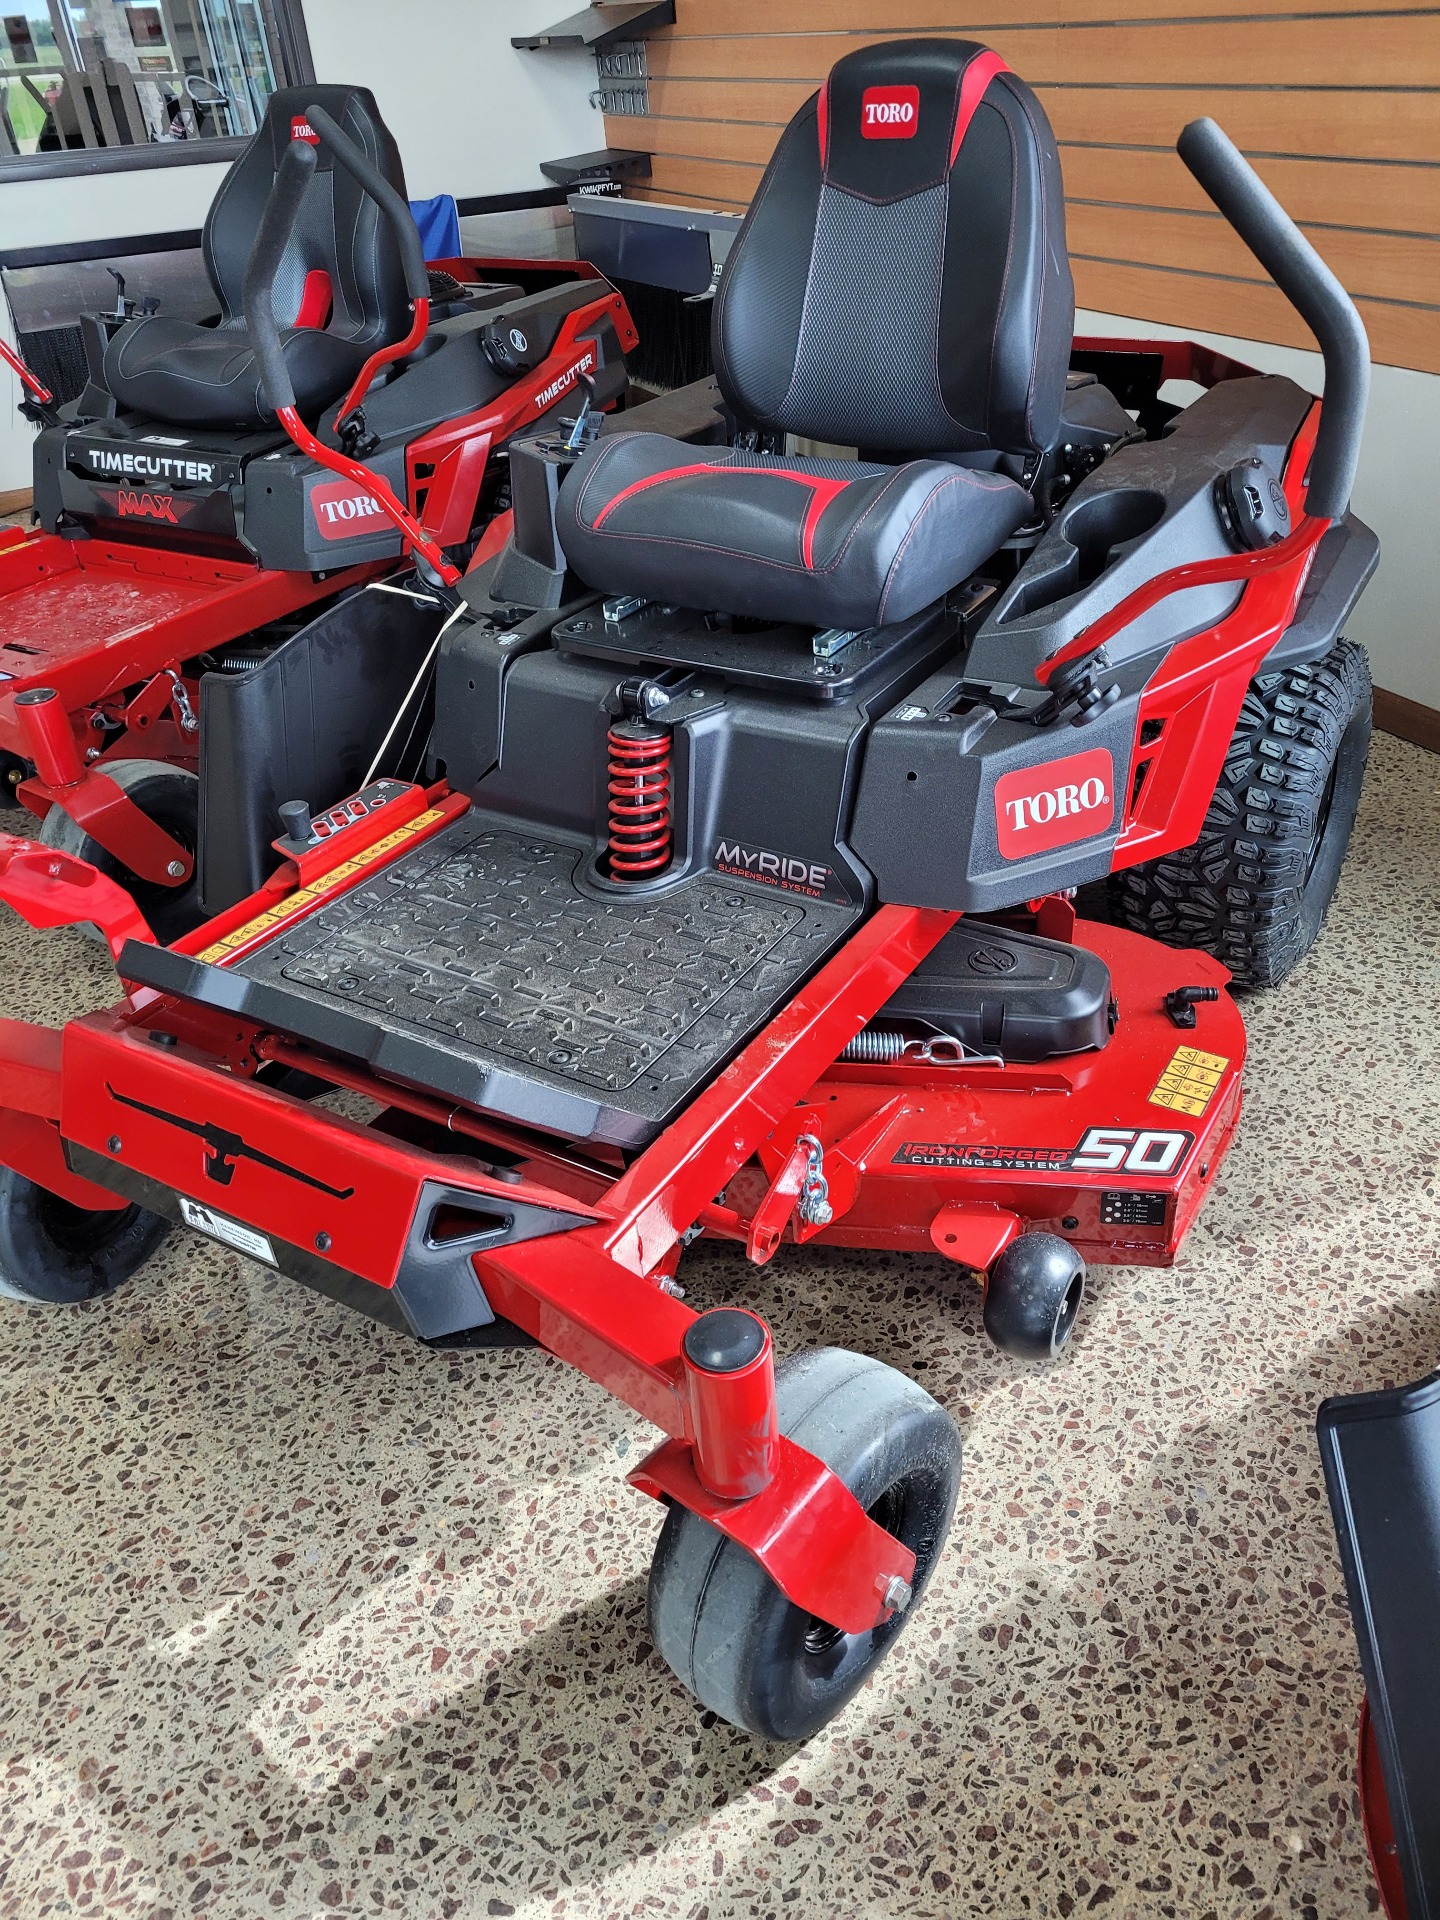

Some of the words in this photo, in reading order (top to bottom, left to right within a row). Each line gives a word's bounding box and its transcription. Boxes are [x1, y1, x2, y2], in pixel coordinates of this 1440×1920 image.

[866, 102, 914, 124] TORO
[534, 353, 594, 409] TIMECUTTER
[88, 449, 213, 483] TIMECUTTER
[118, 490, 179, 524] MAX
[717, 863, 778, 886] SUSPENSION
[780, 880, 821, 898] SYSTEM
[911, 1156, 985, 1166] CUTTING
[992, 1159, 1060, 1170] SYSTEM
[1071, 1129, 1187, 1173] 50
